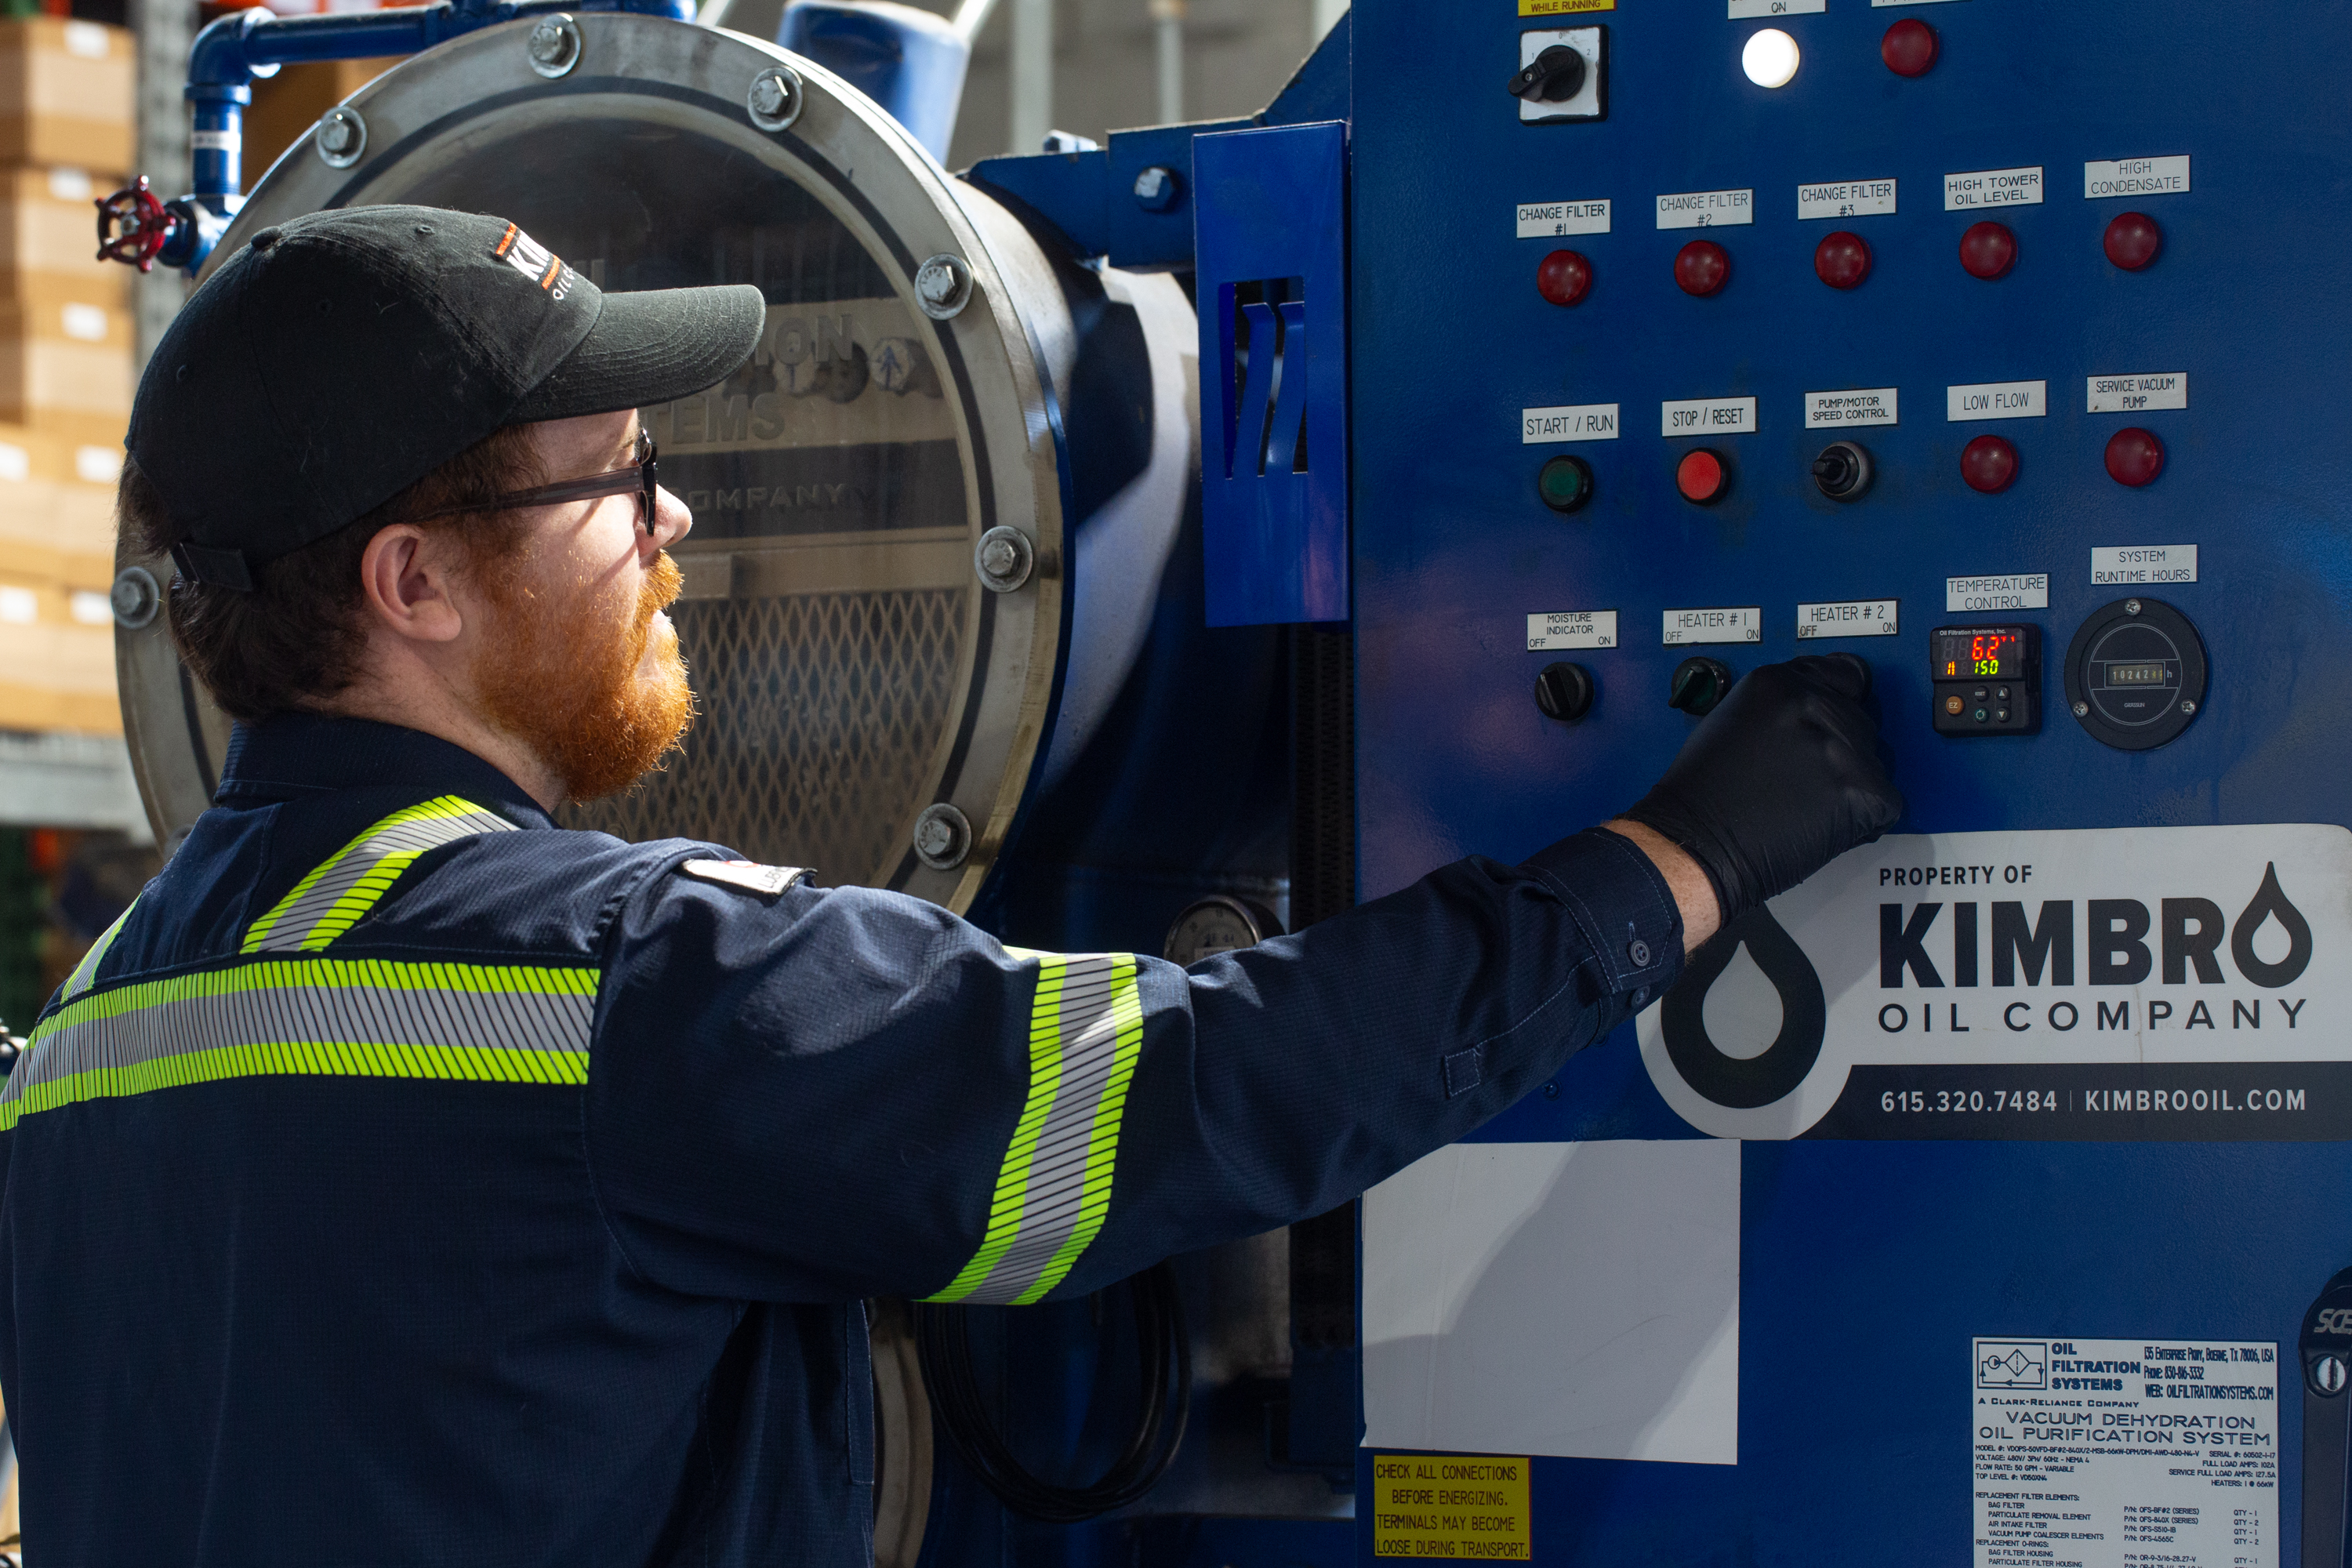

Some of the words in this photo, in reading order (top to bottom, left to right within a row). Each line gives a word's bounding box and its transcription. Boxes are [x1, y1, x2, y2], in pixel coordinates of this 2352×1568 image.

[1531, 2, 1558, 13] WHILE
[1562, 0, 1600, 9] RUNNING
[1771, 2, 1786, 13] ON
[2119, 162, 2151, 175] HIGH
[1948, 179, 1981, 191] HIGH
[1989, 174, 2038, 187] TOWER
[2091, 177, 2181, 194] CONDENSATE
[1801, 186, 1846, 202] CHANGE
[1851, 183, 1891, 198] FILTER
[1955, 193, 1978, 205] OIL
[1984, 189, 2029, 202] LEVEL
[1661, 196, 1704, 211] CHANGE
[1709, 193, 1748, 207] FILTER
[1519, 206, 1562, 221] CHANGE
[1567, 204, 1605, 218] FILTER
[1839, 204, 1854, 217] #3
[1697, 214, 1712, 226] #2
[1555, 223, 1566, 235] #1
[553, 277, 572, 301] OIL
[2096, 379, 2134, 393] SERVICE
[2138, 378, 2175, 390] VACUUM
[1819, 397, 1879, 408] PUMP/MOTOR
[1963, 394, 1989, 410] LOW
[1995, 392, 2029, 408] FLOW
[2123, 397, 2147, 408] PUMP
[1673, 412, 1698, 426] STOP
[1702, 407, 1707, 426] /
[1713, 408, 1744, 424] RESET
[1813, 409, 1842, 421] SPEED
[1846, 408, 1889, 419] CONTROL
[1526, 416, 1569, 436] START
[1575, 416, 1580, 432] /
[1587, 415, 1613, 432] RUN
[2119, 550, 2165, 562] SYSTEM
[2096, 570, 2145, 582] RUNTIME
[2152, 569, 2190, 581] HOURS
[1948, 577, 2045, 593] TEMPERATURE
[1965, 595, 2027, 609] CONTROL
[1547, 613, 1591, 623] MOISTURE
[1678, 613, 1725, 628] HEATER
[1730, 613, 1737, 625] #
[1744, 612, 1747, 626] 1
[1811, 607, 1859, 622] HEATER
[1863, 606, 1871, 619] #
[1877, 605, 1884, 619] 2
[1547, 625, 1593, 636] INDICATOR
[1665, 632, 1682, 641] OFF
[1746, 630, 1759, 639] ON
[1800, 626, 1817, 637] OFF
[1882, 621, 1895, 633] ON
[1529, 638, 1546, 648] OFF
[1598, 636, 1610, 645] ON
[1972, 636, 2000, 661] 62
[1975, 660, 1999, 675] 150
[1880, 866, 1995, 886] PROPERTY
[2004, 865, 2032, 883] OF
[1880, 861, 2312, 988] KIMBRO
[1878, 1004, 1969, 1033] OIL
[2004, 998, 2306, 1031] COMPANY
[1881, 1091, 2057, 1112] 615.320.7484
[2085, 1089, 2306, 1111] KIMBROOIL.COM
[2052, 1343, 2077, 1355] OIL
[2052, 1360, 2140, 1373] FILTRATION
[2165, 1366, 2204, 1380] 830-816-3332
[2052, 1377, 2123, 1390] SYSTEMS
[2145, 1384, 2163, 1397] WEB:
[2167, 1385, 2273, 1400] OILFILTRATIONSYSTEMS.COM
[2006, 1411, 2092, 1425] VACUUM
[2103, 1414, 2254, 1428] DEHYDRATION
[1980, 1427, 2013, 1439] OIL
[2024, 1428, 2172, 1443] PURIFICATION
[2183, 1431, 2270, 1445] SYSTEM
[1376, 1464, 1410, 1479] CHECK
[1416, 1465, 1437, 1479] ALL
[1442, 1465, 1517, 1481] CONNECTIONS
[1392, 1490, 1433, 1504] BEFORE
[1439, 1490, 1508, 1505] ENERGIZING.
[1377, 1514, 1437, 1529] TERMINALS
[1443, 1516, 1466, 1530] MAY
[1472, 1517, 1515, 1531] BECOME
[1377, 1539, 1410, 1553] LOOSE
[1417, 1541, 1454, 1555] DURING
[1461, 1541, 1528, 1557] TRANSPORT.
